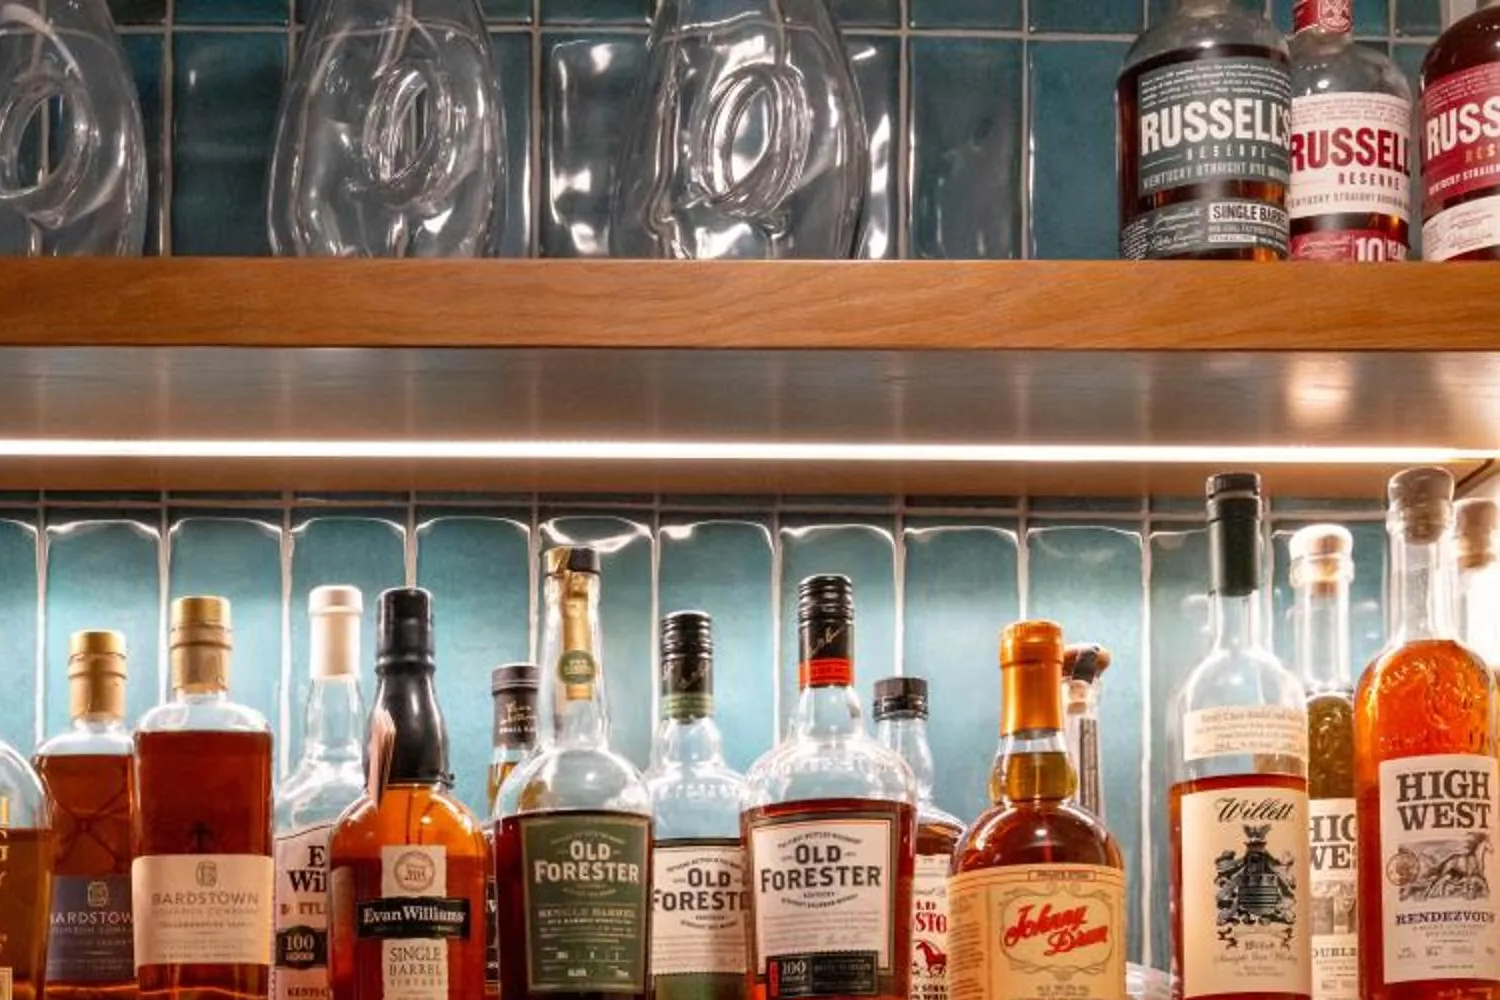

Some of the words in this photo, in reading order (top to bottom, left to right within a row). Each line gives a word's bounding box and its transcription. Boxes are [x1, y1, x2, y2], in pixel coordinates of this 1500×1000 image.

[1140, 97, 1291, 156] RUSSELL'S
[1186, 144, 1267, 160] RESERVE
[1143, 166, 1192, 189] KENTUCKY
[1195, 161, 1246, 180] STRAIGHT
[1337, 171, 1400, 191] RESERVE
[1212, 204, 1257, 220] SINGLE
[1355, 237, 1384, 262] 10
[1395, 769, 1491, 802] HIGH
[1213, 796, 1295, 823] Willett
[1397, 801, 1492, 831] WEST
[569, 840, 611, 860] OLD
[795, 843, 842, 865] OLD
[533, 860, 640, 885] FORESTER
[688, 867, 731, 887] OLD
[760, 865, 882, 894] FORESTER
[151, 892, 260, 907] BARDSTOWN
[363, 907, 403, 925] Evan
[403, 905, 466, 924] Williams
[1003, 902, 1088, 947] Johnny
[286, 934, 315, 951] 100
[388, 947, 442, 963] SINGLE
[388, 963, 442, 977] BARREL
